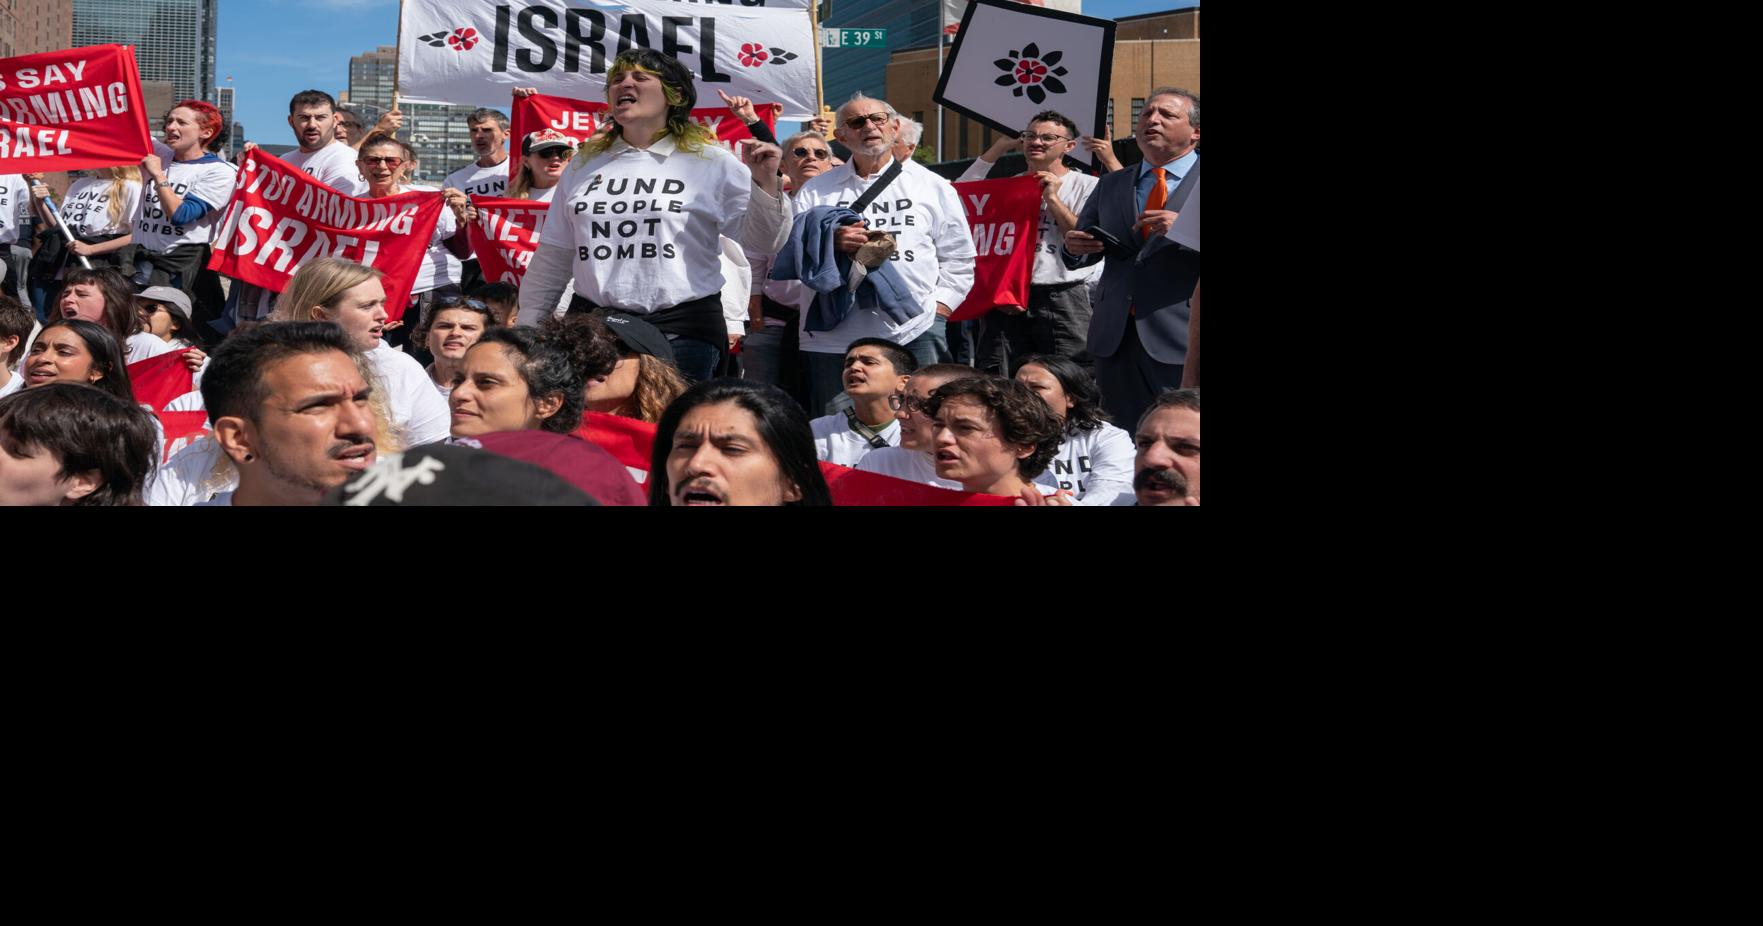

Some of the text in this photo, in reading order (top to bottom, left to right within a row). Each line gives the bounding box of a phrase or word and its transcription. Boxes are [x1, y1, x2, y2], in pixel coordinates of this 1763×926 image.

[841, 31, 882, 45] E 39 St
[15, 60, 87, 89] SAY
[464, 180, 506, 196] FUN
[296, 182, 420, 236] ARMING
[574, 199, 683, 215] PEOPLE
[591, 218, 662, 239] NOT
[578, 242, 676, 261] BOMBS
